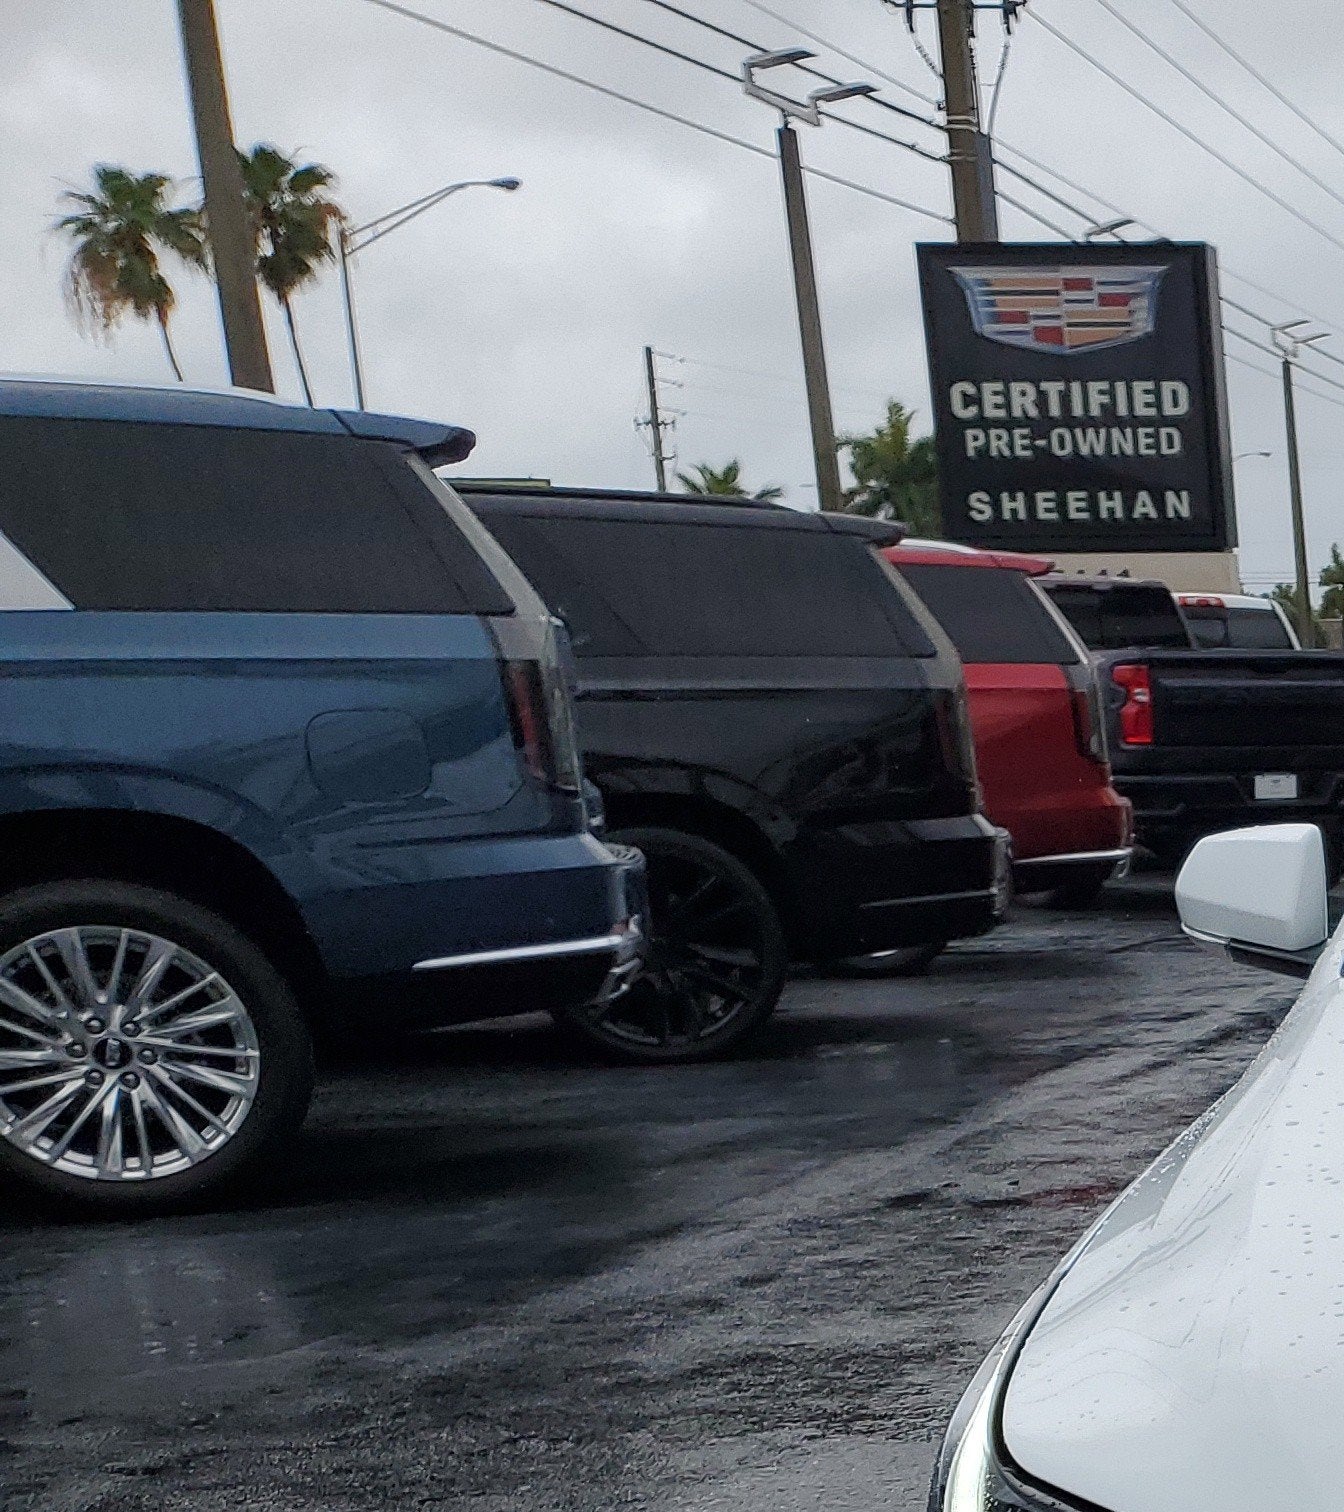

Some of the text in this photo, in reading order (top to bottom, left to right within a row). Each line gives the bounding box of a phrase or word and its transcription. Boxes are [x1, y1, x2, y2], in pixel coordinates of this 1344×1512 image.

[949, 380, 1191, 420] CERTIFIED
[965, 426, 1183, 459] PRE-OWNED
[967, 489, 1192, 523] SHEEHAN
